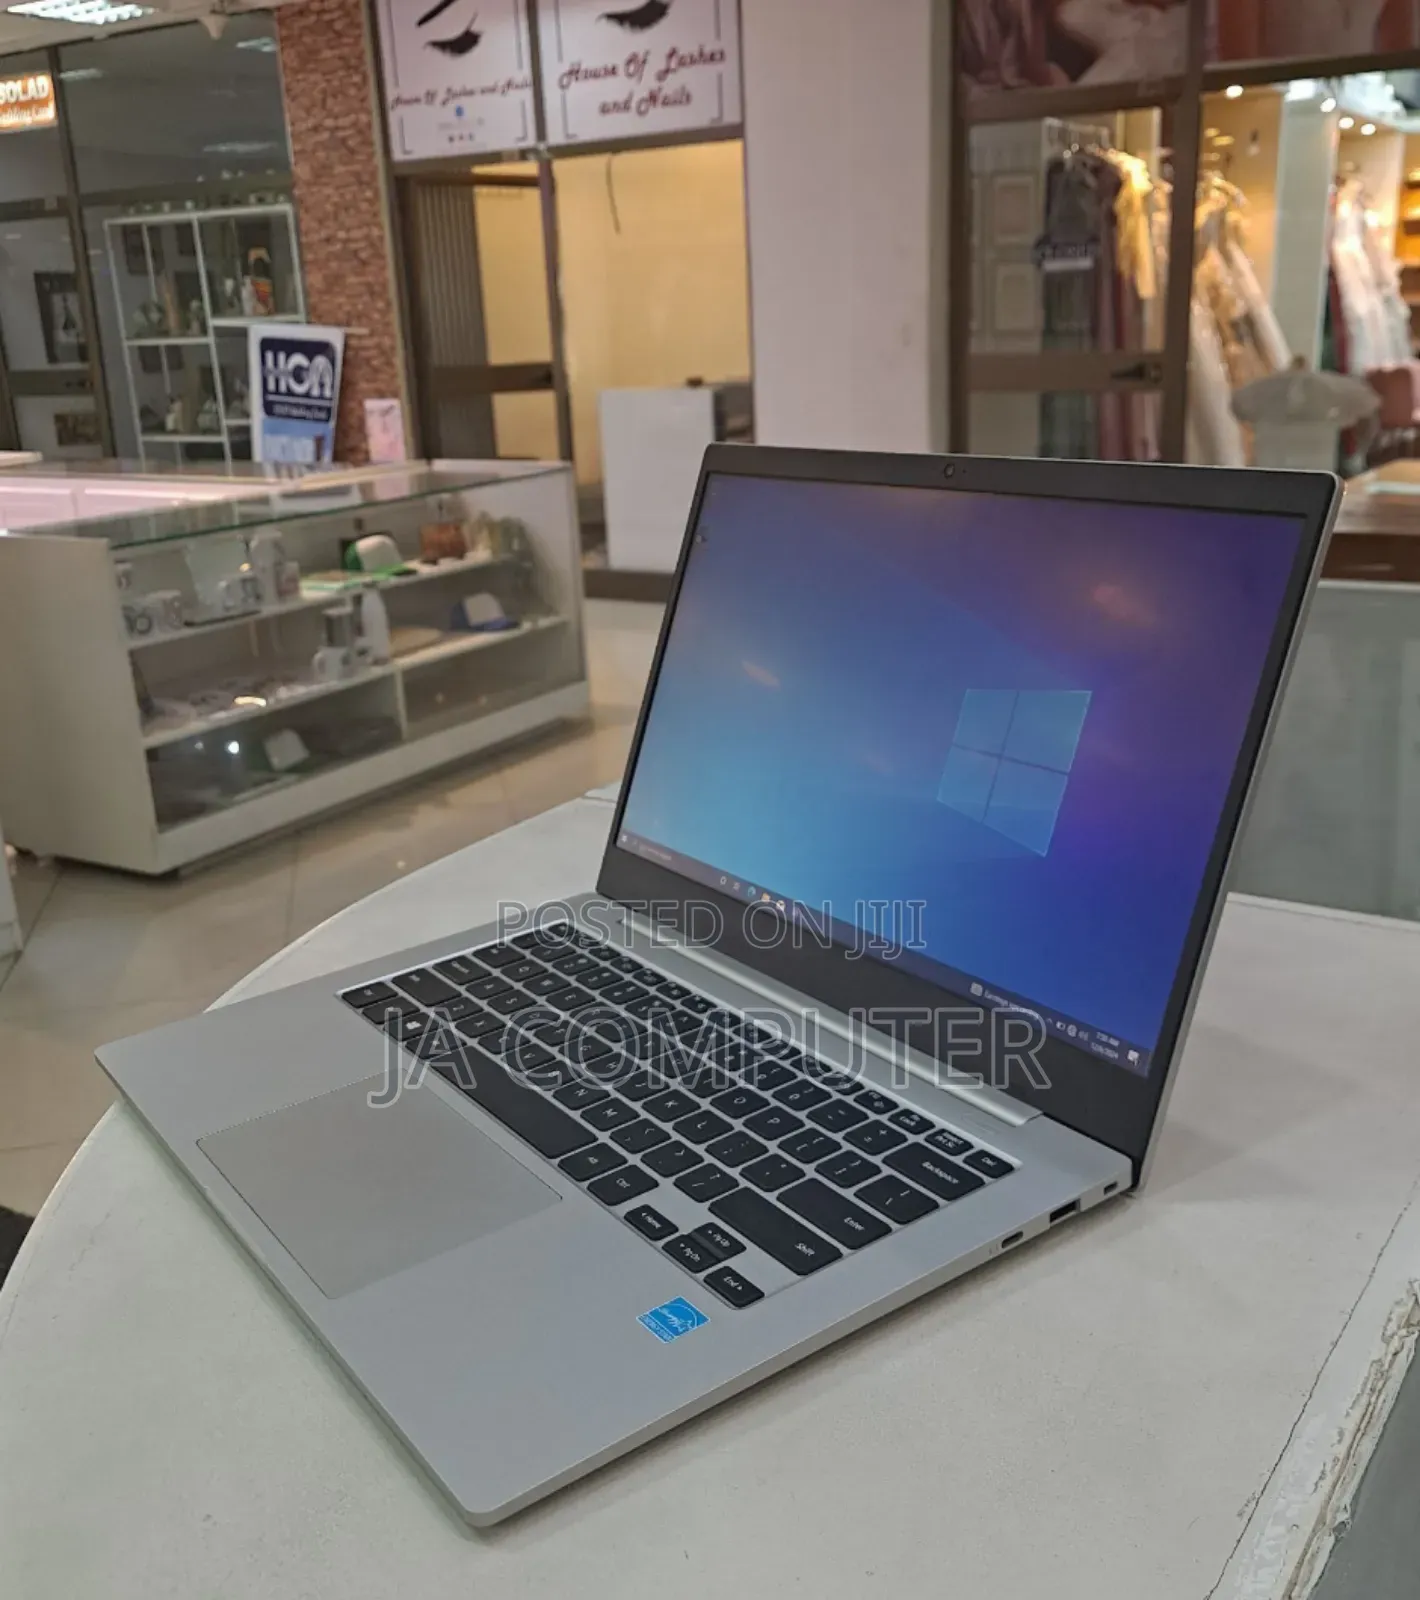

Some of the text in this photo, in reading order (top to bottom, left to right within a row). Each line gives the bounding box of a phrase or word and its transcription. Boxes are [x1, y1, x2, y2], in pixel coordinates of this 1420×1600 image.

[558, 45, 727, 90] House Of Lashes
[599, 85, 693, 117] and Nails
[844, 1216, 865, 1231] Enter
[795, 1242, 816, 1257] Shift
